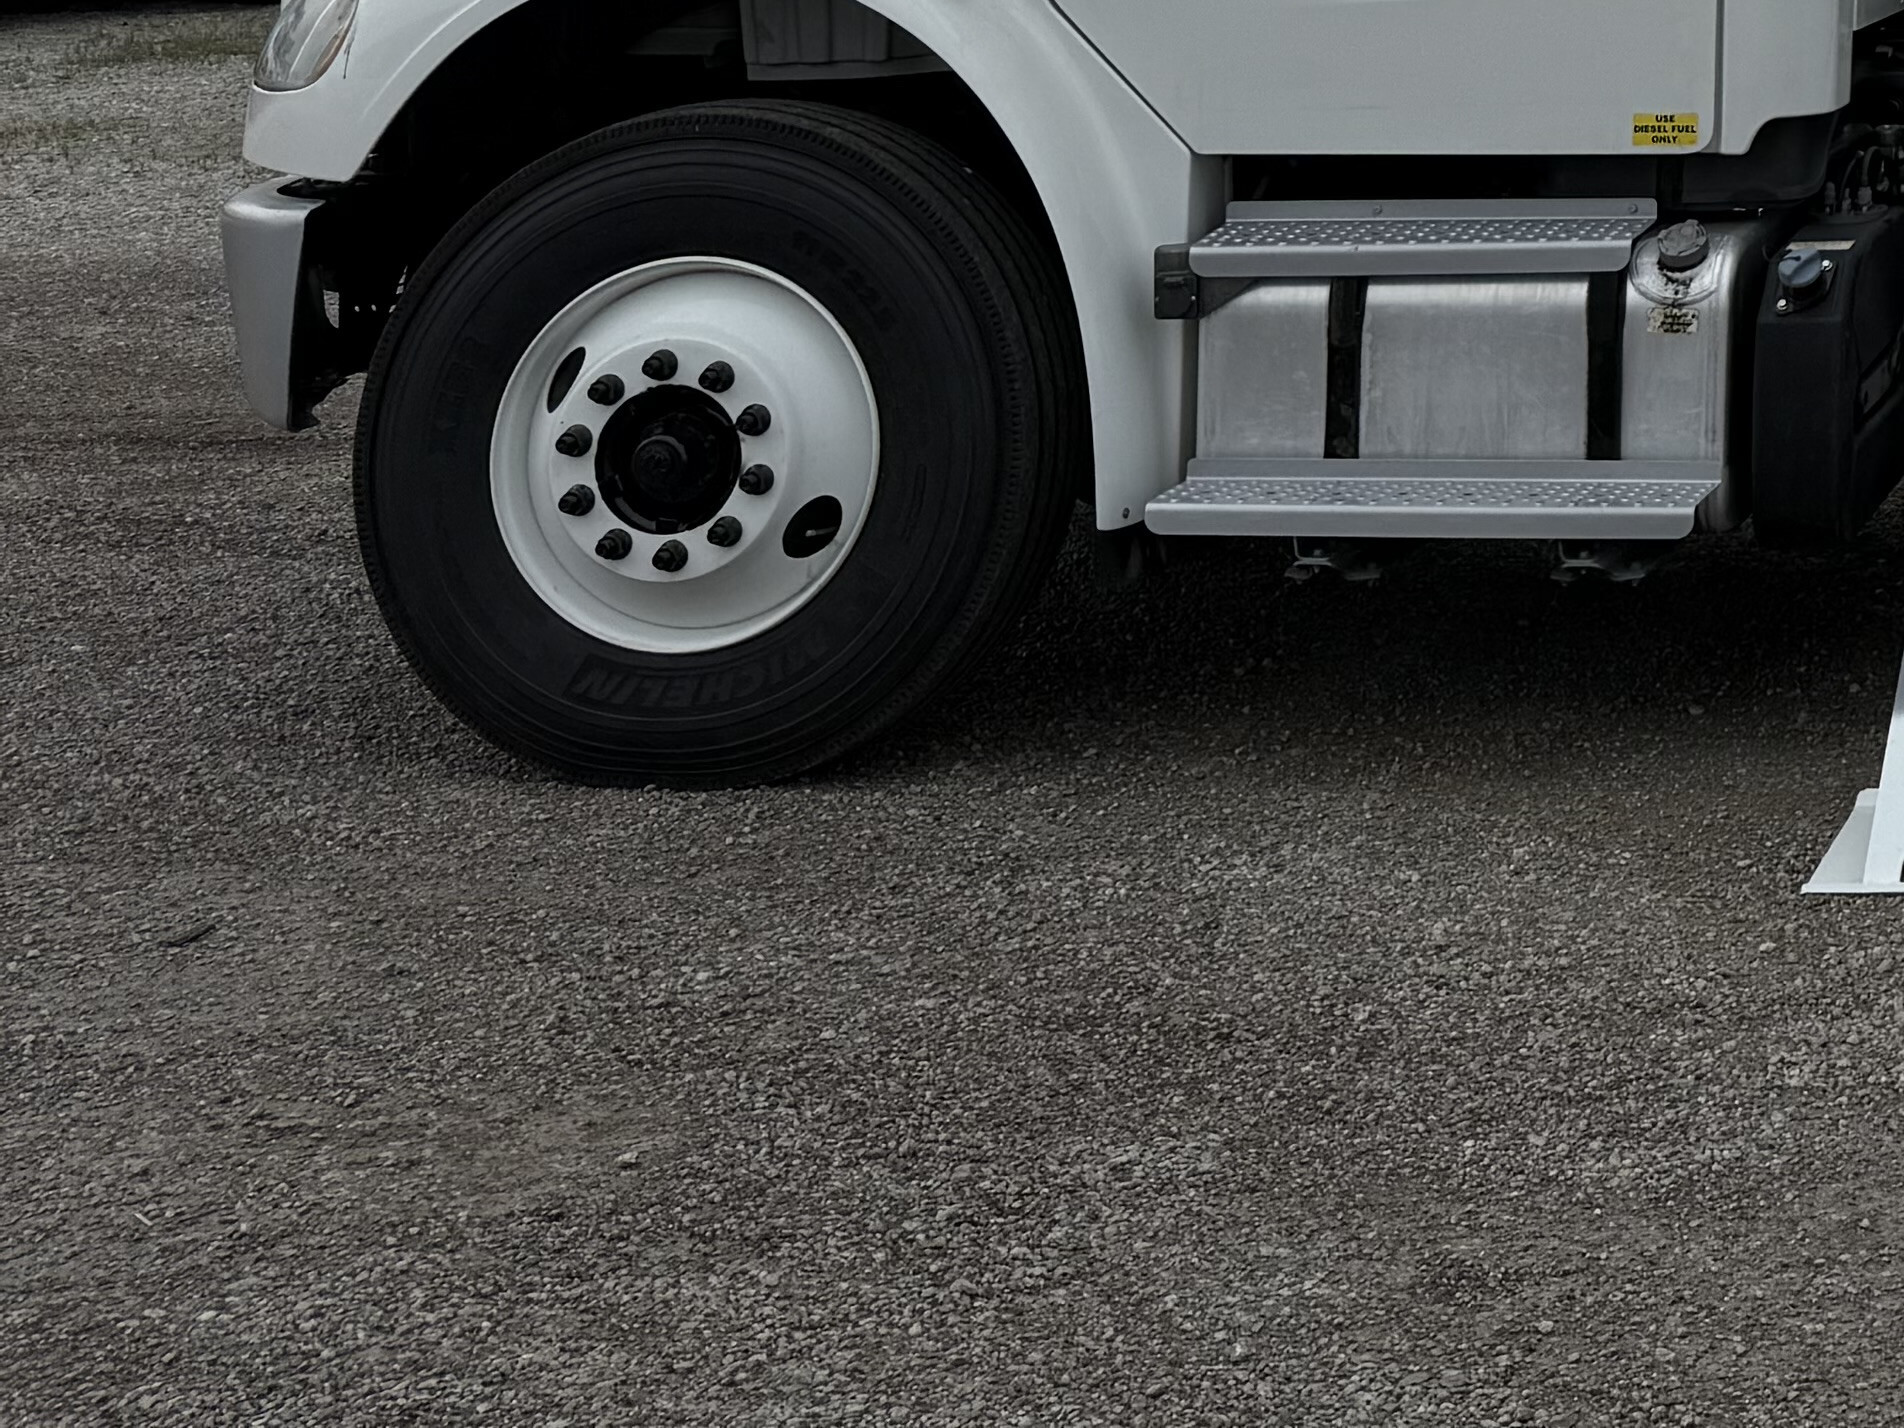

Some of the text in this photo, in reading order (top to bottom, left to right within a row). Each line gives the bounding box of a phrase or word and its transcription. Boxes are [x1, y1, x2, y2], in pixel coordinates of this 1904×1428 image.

[1655, 114, 1675, 123] USE
[1634, 125, 1697, 133] DIESEL FUEL
[1651, 135, 1678, 144] ONLY
[572, 621, 833, 707] MICHELIN
